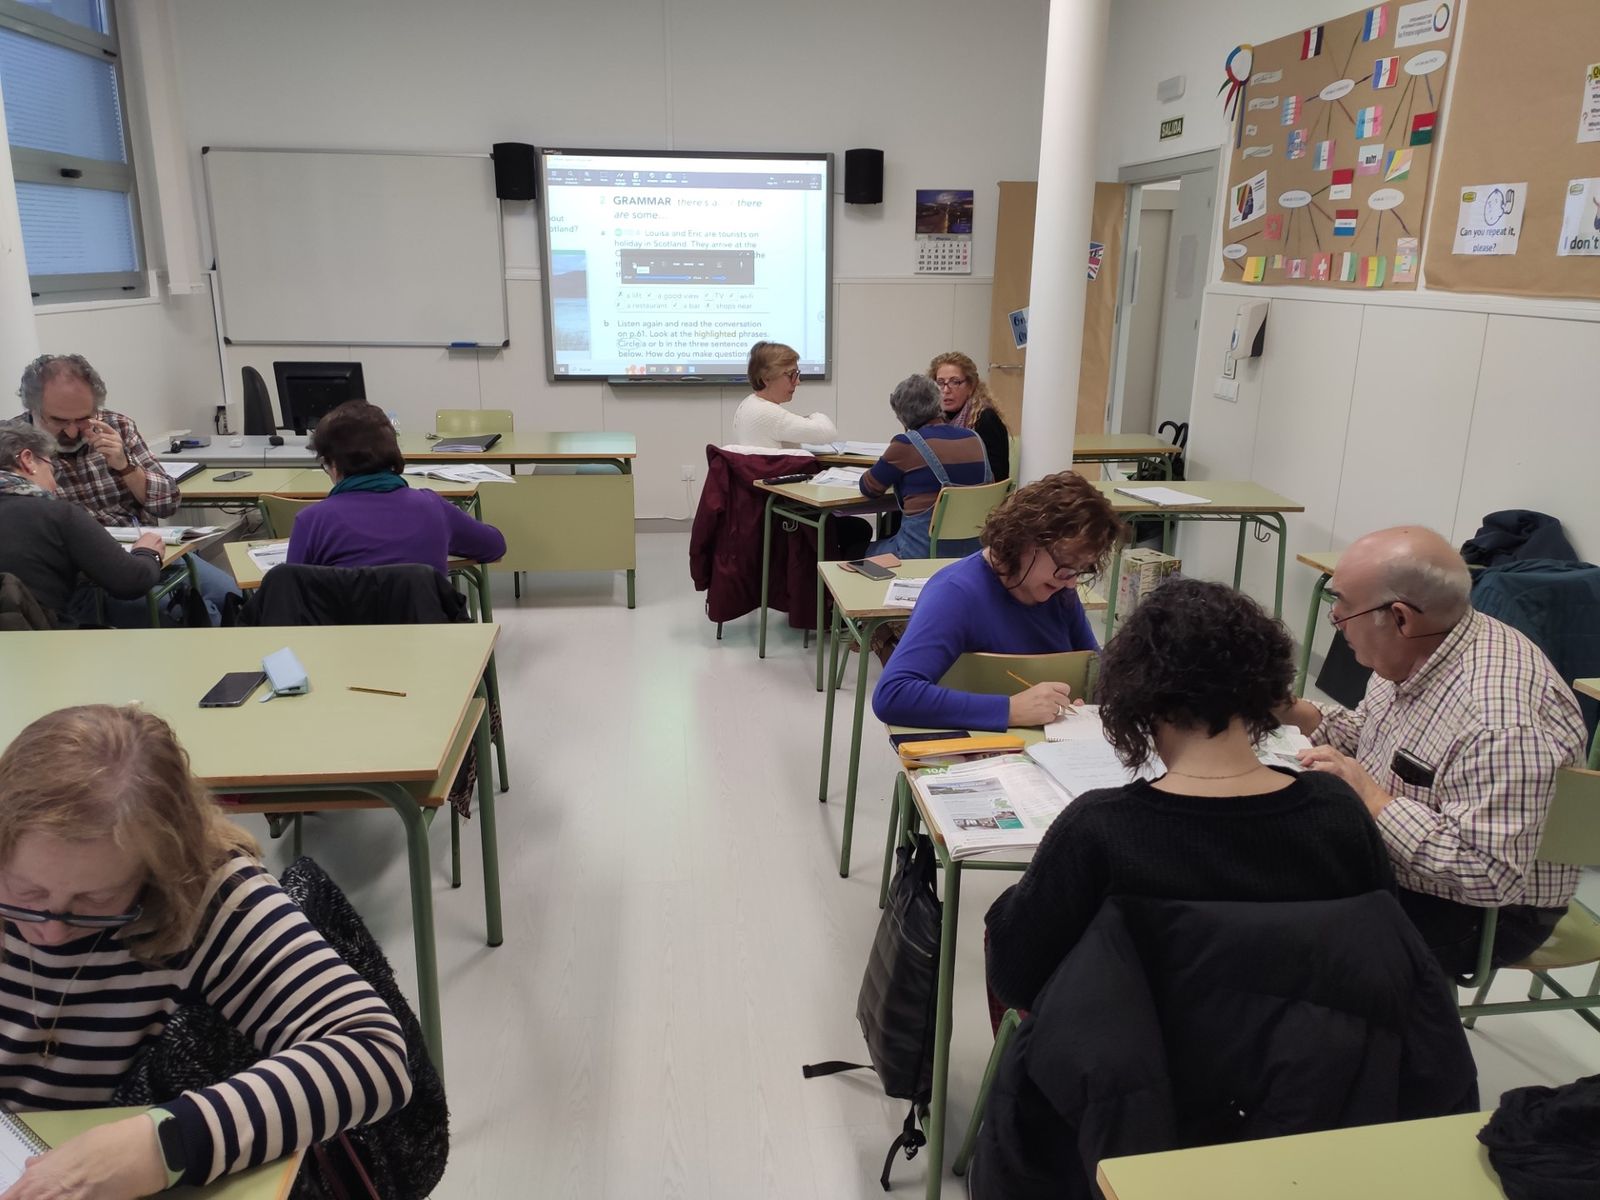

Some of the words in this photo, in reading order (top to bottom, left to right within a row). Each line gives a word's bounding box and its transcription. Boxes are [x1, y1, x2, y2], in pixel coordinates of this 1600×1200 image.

[613, 195, 672, 206] GRAMMAR
[1460, 227, 1472, 237] Can
[1473, 228, 1484, 239] you
[1486, 227, 1507, 238] repeat
[614, 240, 642, 249] holiday
[1472, 243, 1497, 253] please?
[604, 319, 610, 327] b
[642, 320, 663, 329] again
[649, 330, 668, 338] Look
[680, 330, 692, 338] the
[694, 330, 737, 340] highlighted
[739, 331, 770, 340] phrases.
[689, 340, 709, 348] three
